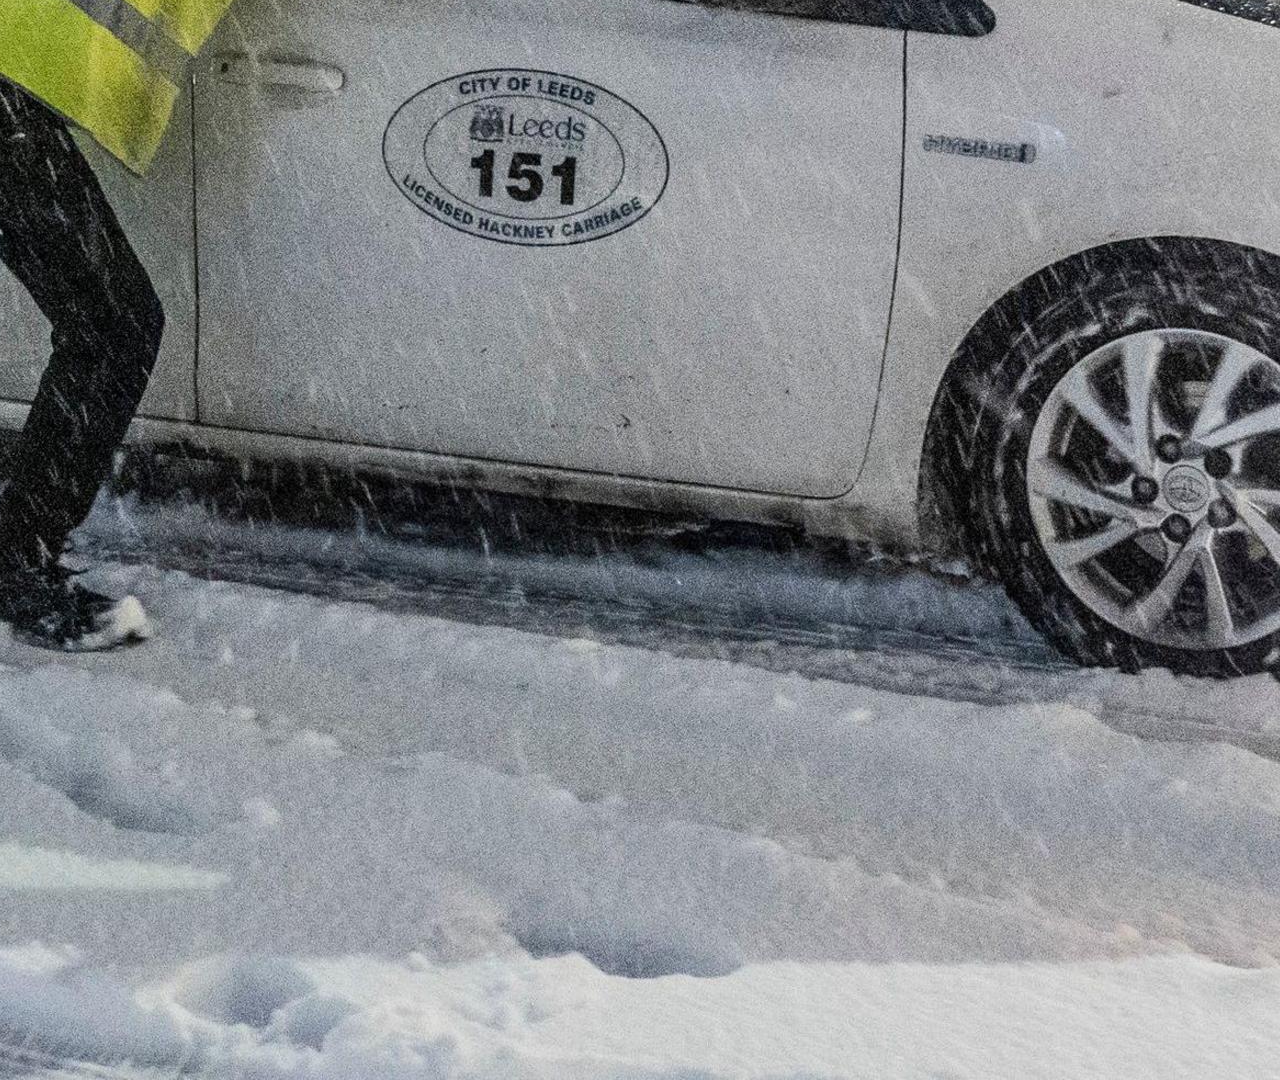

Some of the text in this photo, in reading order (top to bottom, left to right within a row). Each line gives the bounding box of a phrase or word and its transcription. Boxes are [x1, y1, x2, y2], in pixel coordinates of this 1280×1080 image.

[458, 75, 597, 106] CITY OF LEEDS
[508, 113, 587, 143] Leeds
[470, 148, 578, 206] 151
[402, 173, 644, 239] LICENSED HACKNEY CARRIAGE
